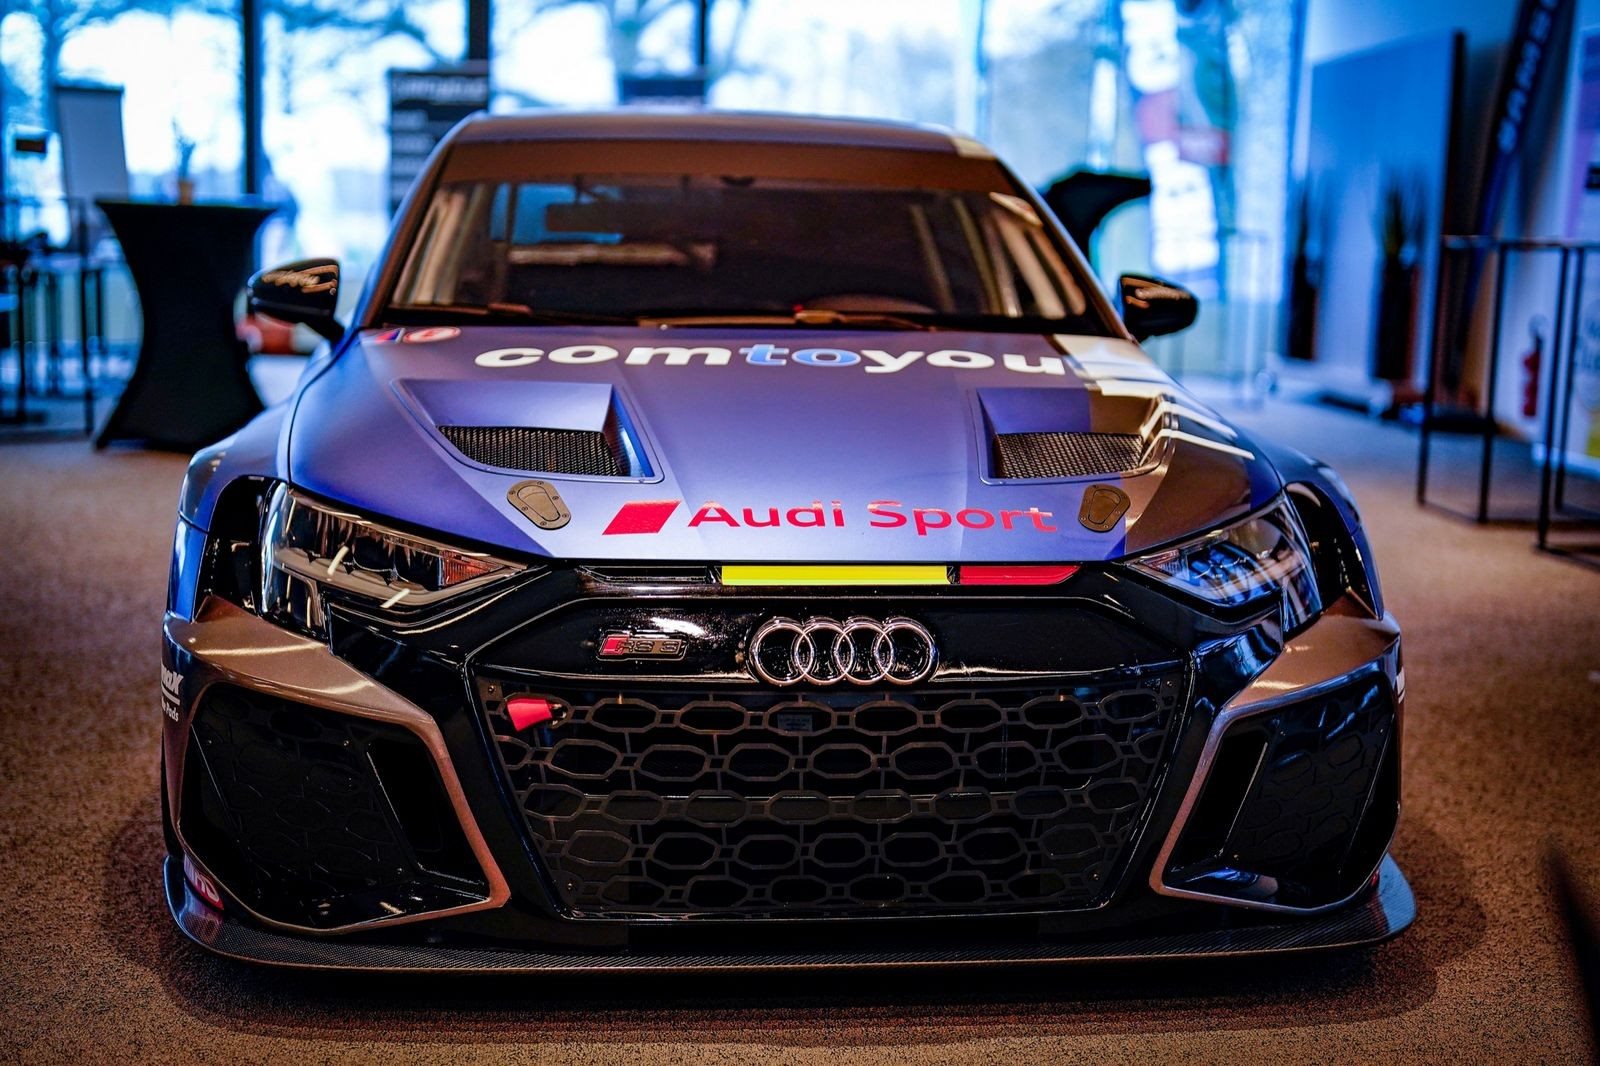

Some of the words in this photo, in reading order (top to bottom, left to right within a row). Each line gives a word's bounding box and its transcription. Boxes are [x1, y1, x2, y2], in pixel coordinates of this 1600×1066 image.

[475, 344, 1066, 375] comtoyou
[687, 501, 845, 528] Audi
[867, 501, 1057, 535] Sport
[616, 640, 655, 653] RS
[659, 640, 679, 653] 3
